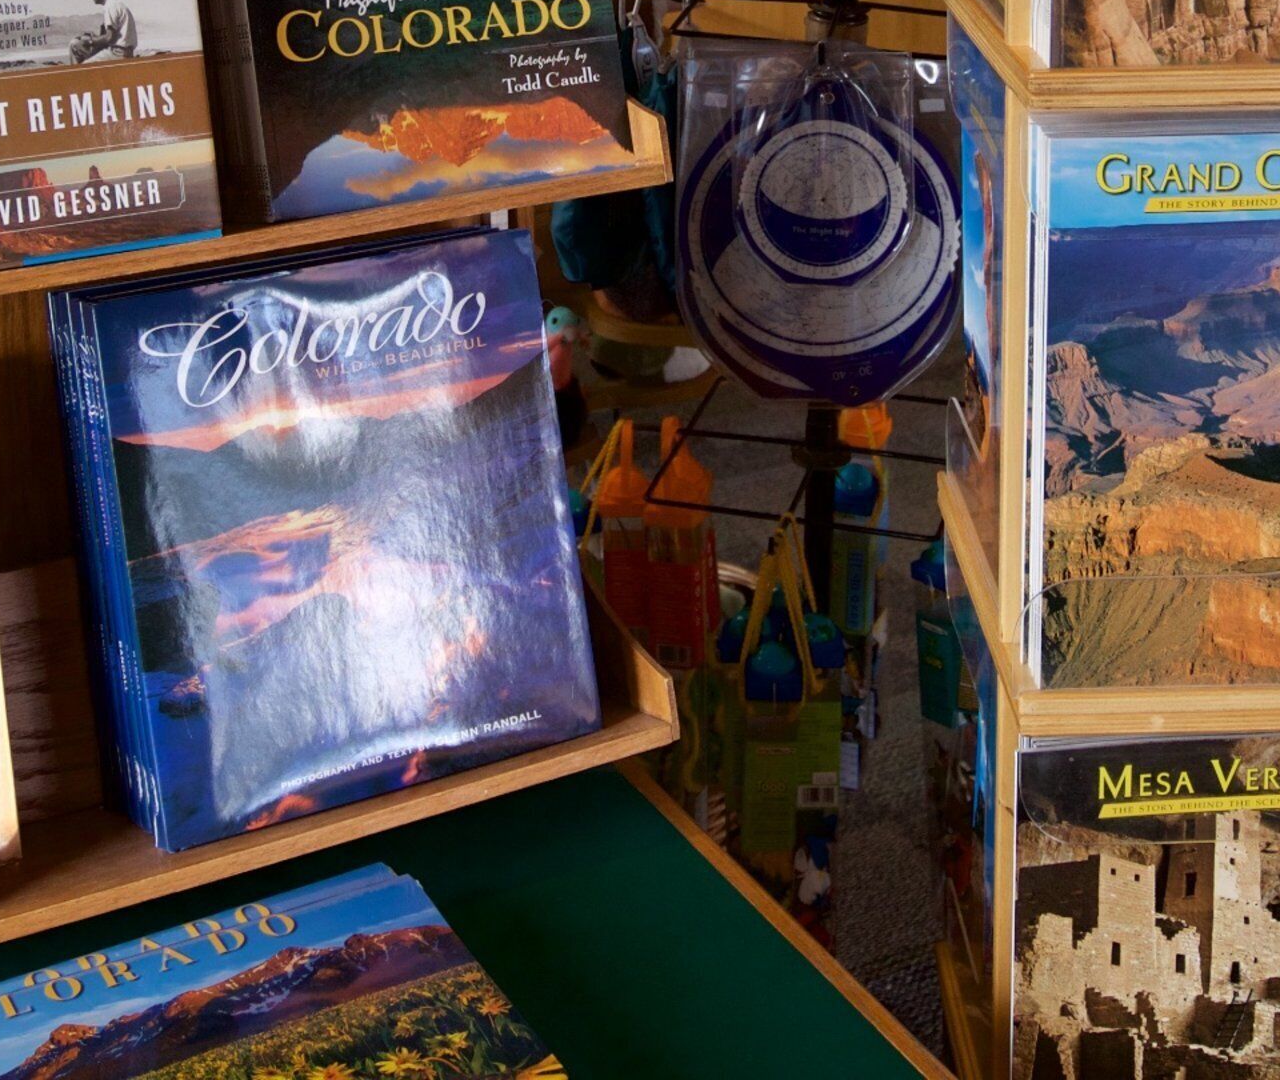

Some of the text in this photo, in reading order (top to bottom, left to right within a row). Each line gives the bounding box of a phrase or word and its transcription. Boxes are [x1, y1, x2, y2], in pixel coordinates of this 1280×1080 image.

[21, 33, 47, 46] West
[502, 67, 600, 94] Todd Caudle
[27, 82, 175, 133] REMAINS
[1096, 153, 1242, 194] GRAND
[54, 179, 161, 218] GESSNER
[139, 271, 486, 408] Colorado
[315, 337, 486, 379] WILD BEAUTIFUL
[118, 640, 129, 692] RANDALL
[1098, 764, 1195, 800] MESA
